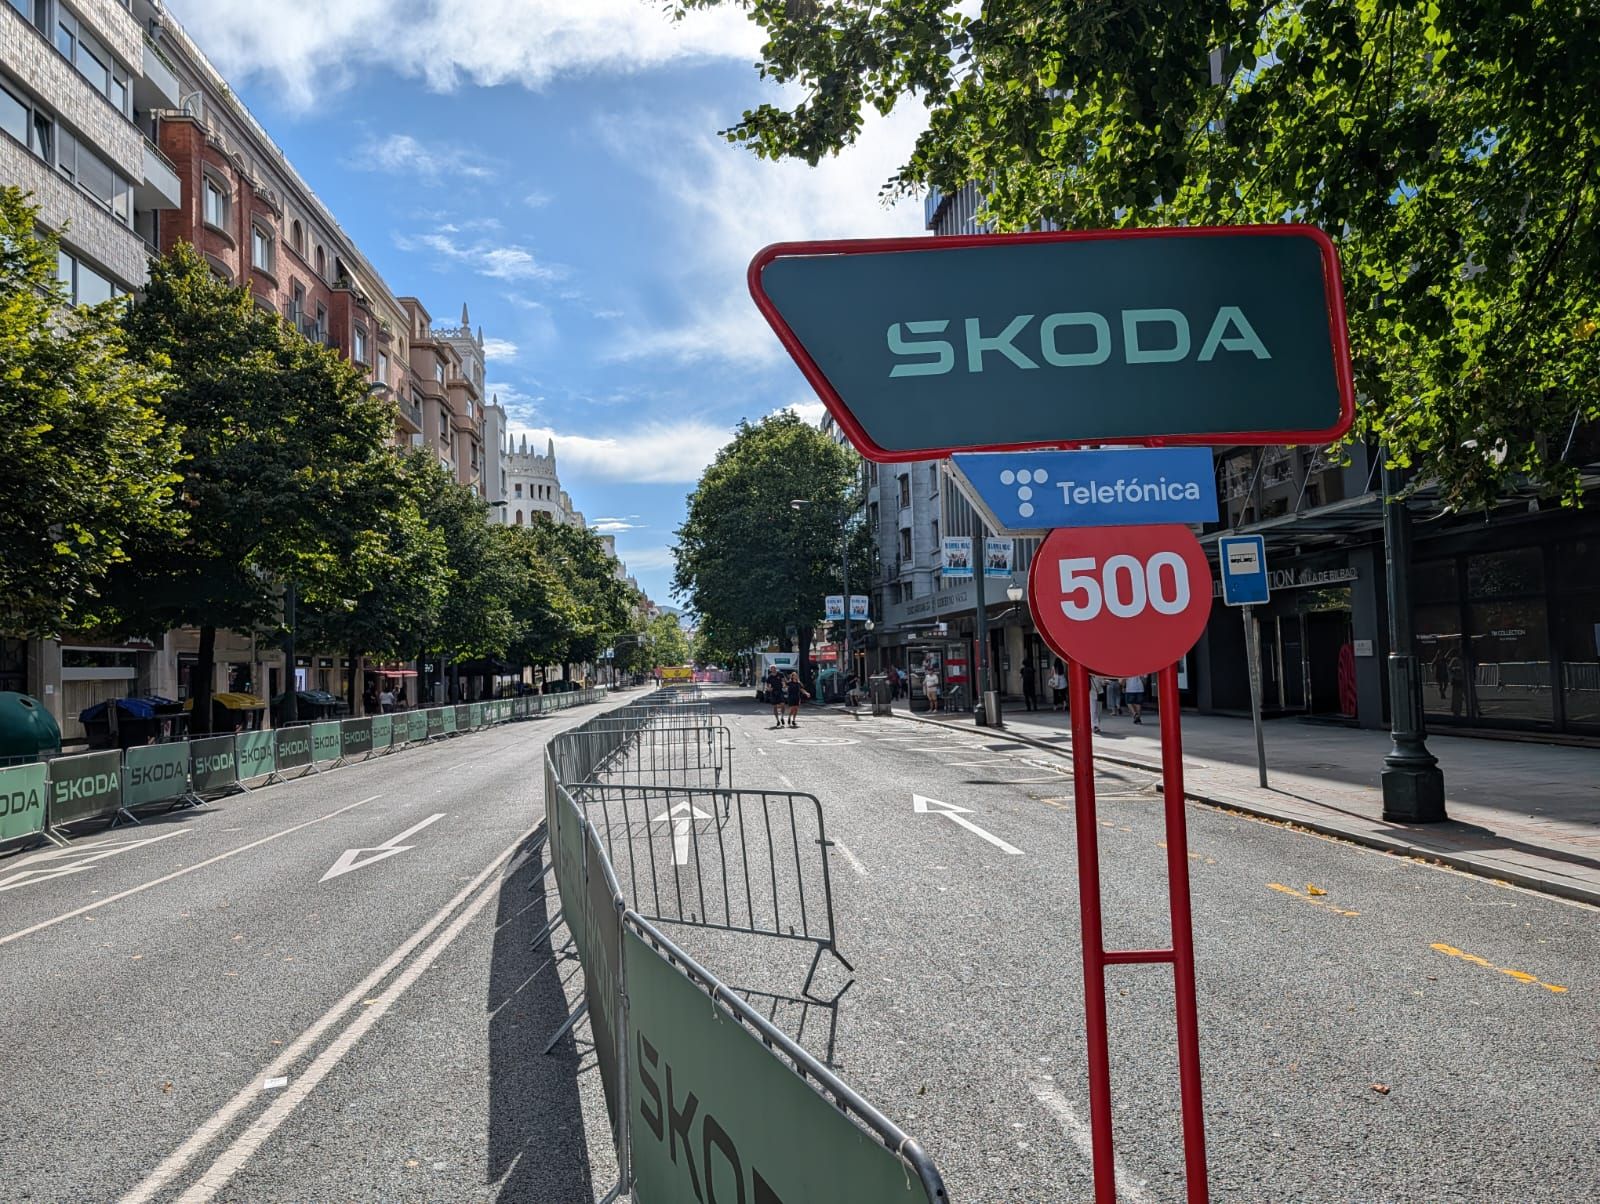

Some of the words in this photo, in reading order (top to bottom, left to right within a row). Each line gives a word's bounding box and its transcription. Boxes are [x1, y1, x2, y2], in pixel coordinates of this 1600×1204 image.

[887, 306, 1272, 378] SKODA
[1056, 477, 1200, 505] Telefónica
[1318, 571, 1329, 582] DE
[1330, 567, 1356, 580] BILBAO
[1059, 552, 1190, 621] 500
[314, 735, 340, 749] SKODA
[344, 730, 371, 744] SKODA
[373, 726, 391, 738] SKODA
[240, 744, 273, 765] SKODA
[279, 739, 310, 757] SKODA
[130, 761, 184, 786] SKODA
[196, 752, 235, 774] SKODA
[56, 772, 119, 803] SKODA
